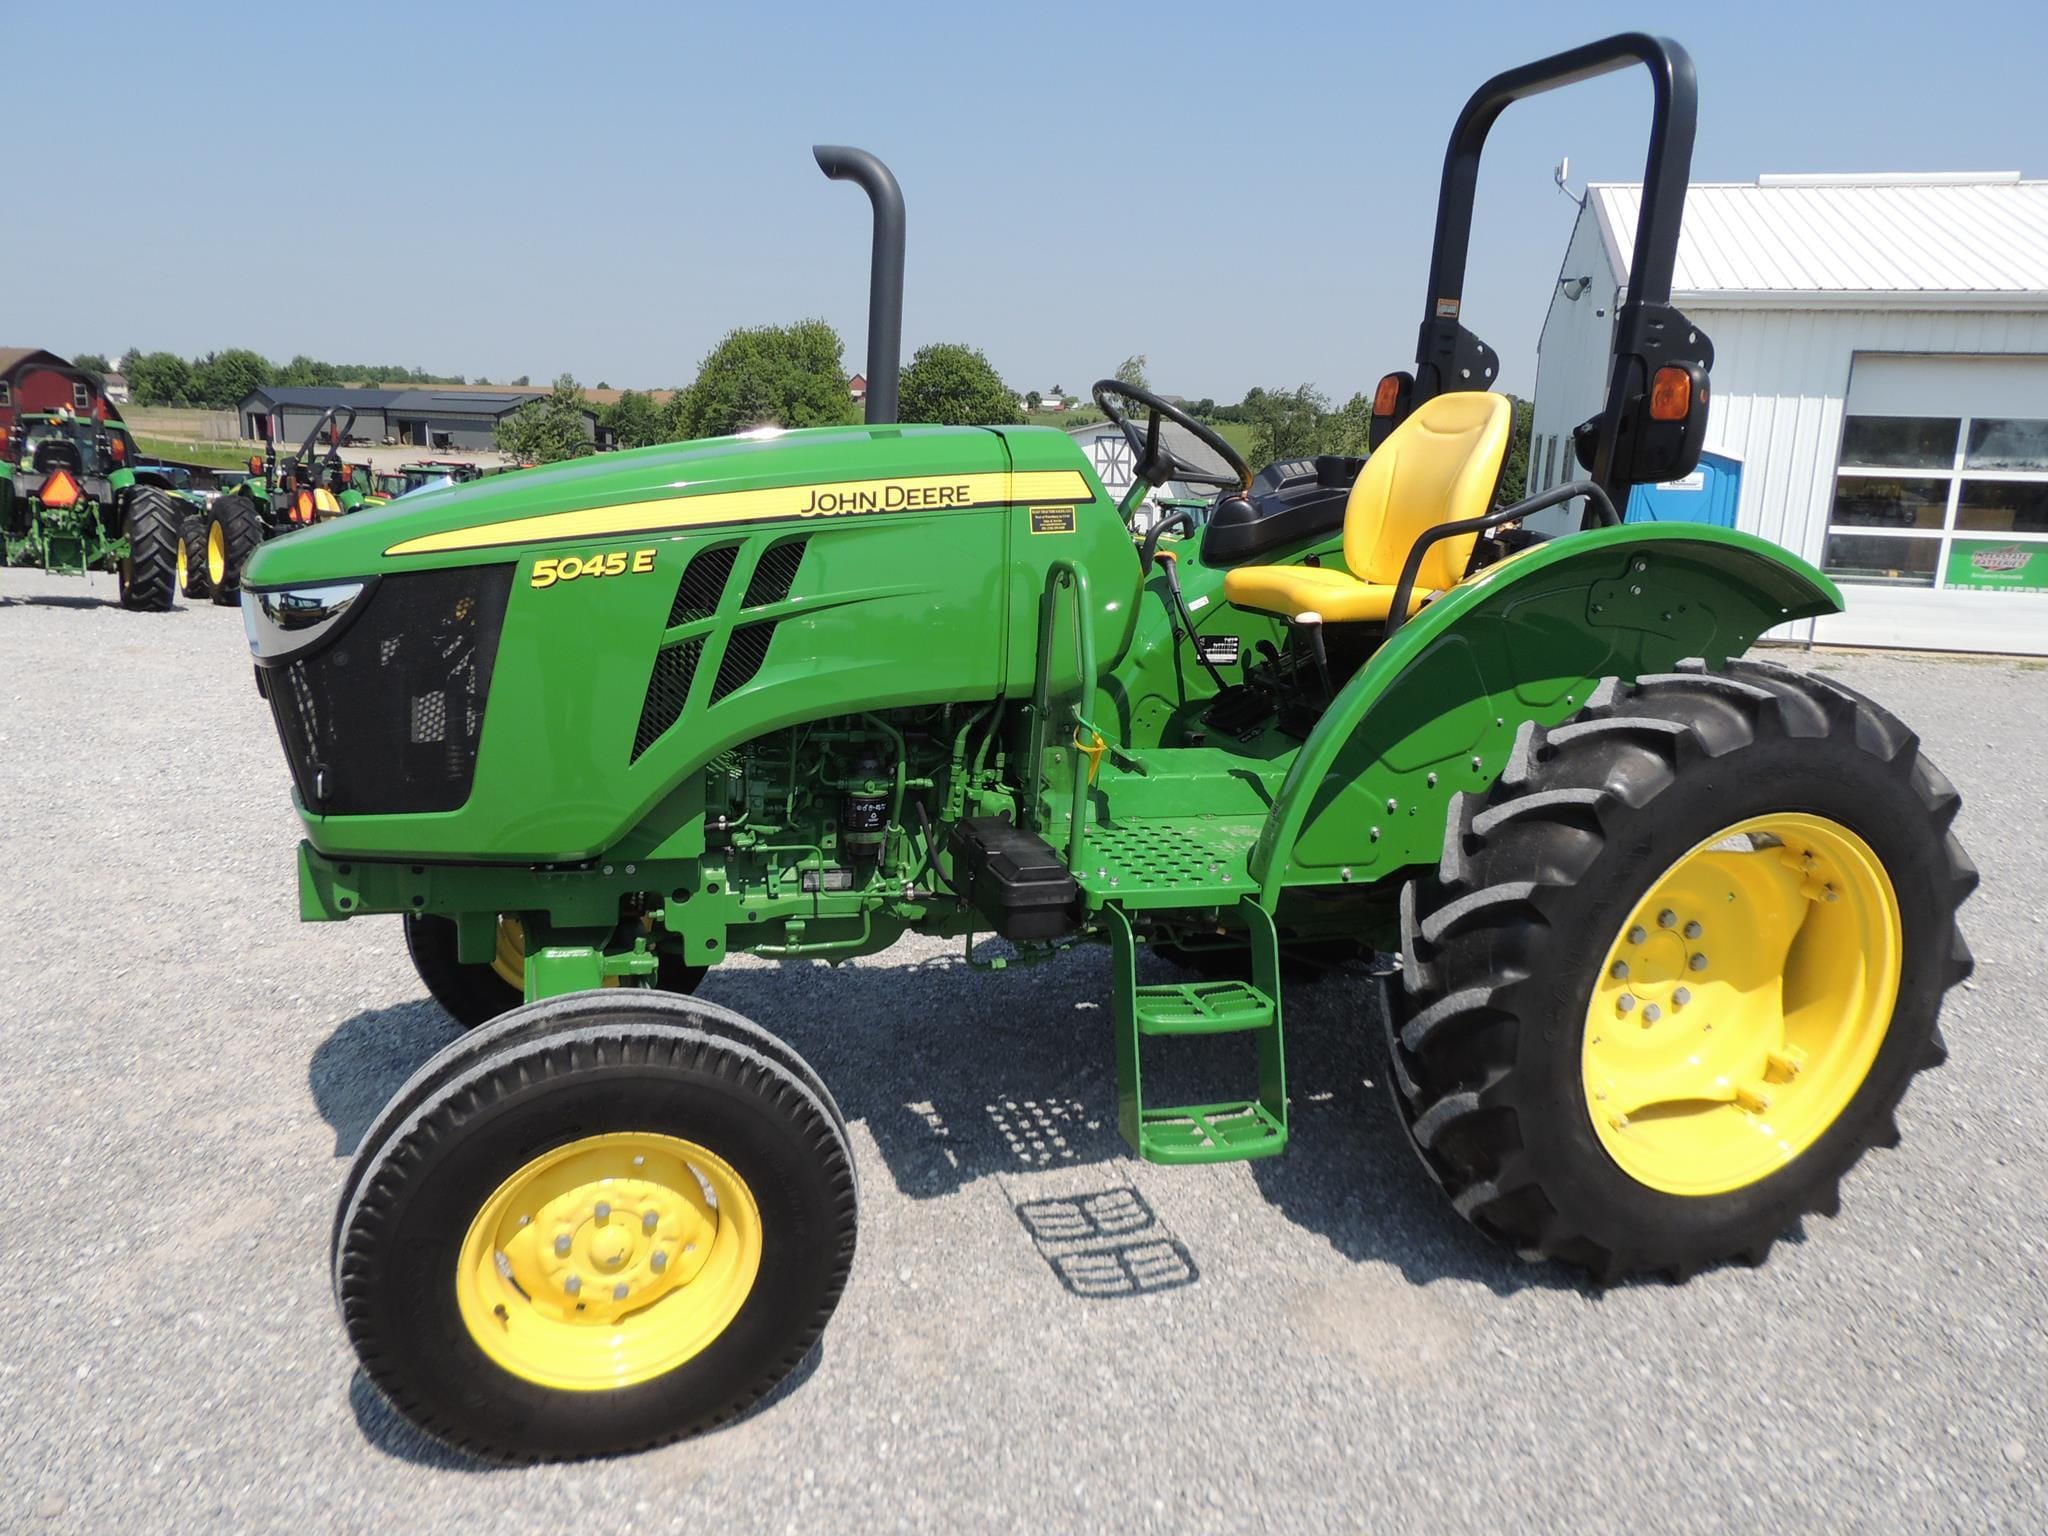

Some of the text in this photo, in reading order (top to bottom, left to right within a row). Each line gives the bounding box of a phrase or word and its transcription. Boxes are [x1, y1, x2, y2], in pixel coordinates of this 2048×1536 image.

[800, 484, 971, 514] JOHN DEERE
[530, 549, 657, 588] 5045 E
[1973, 559, 2023, 567] BATTERIES
